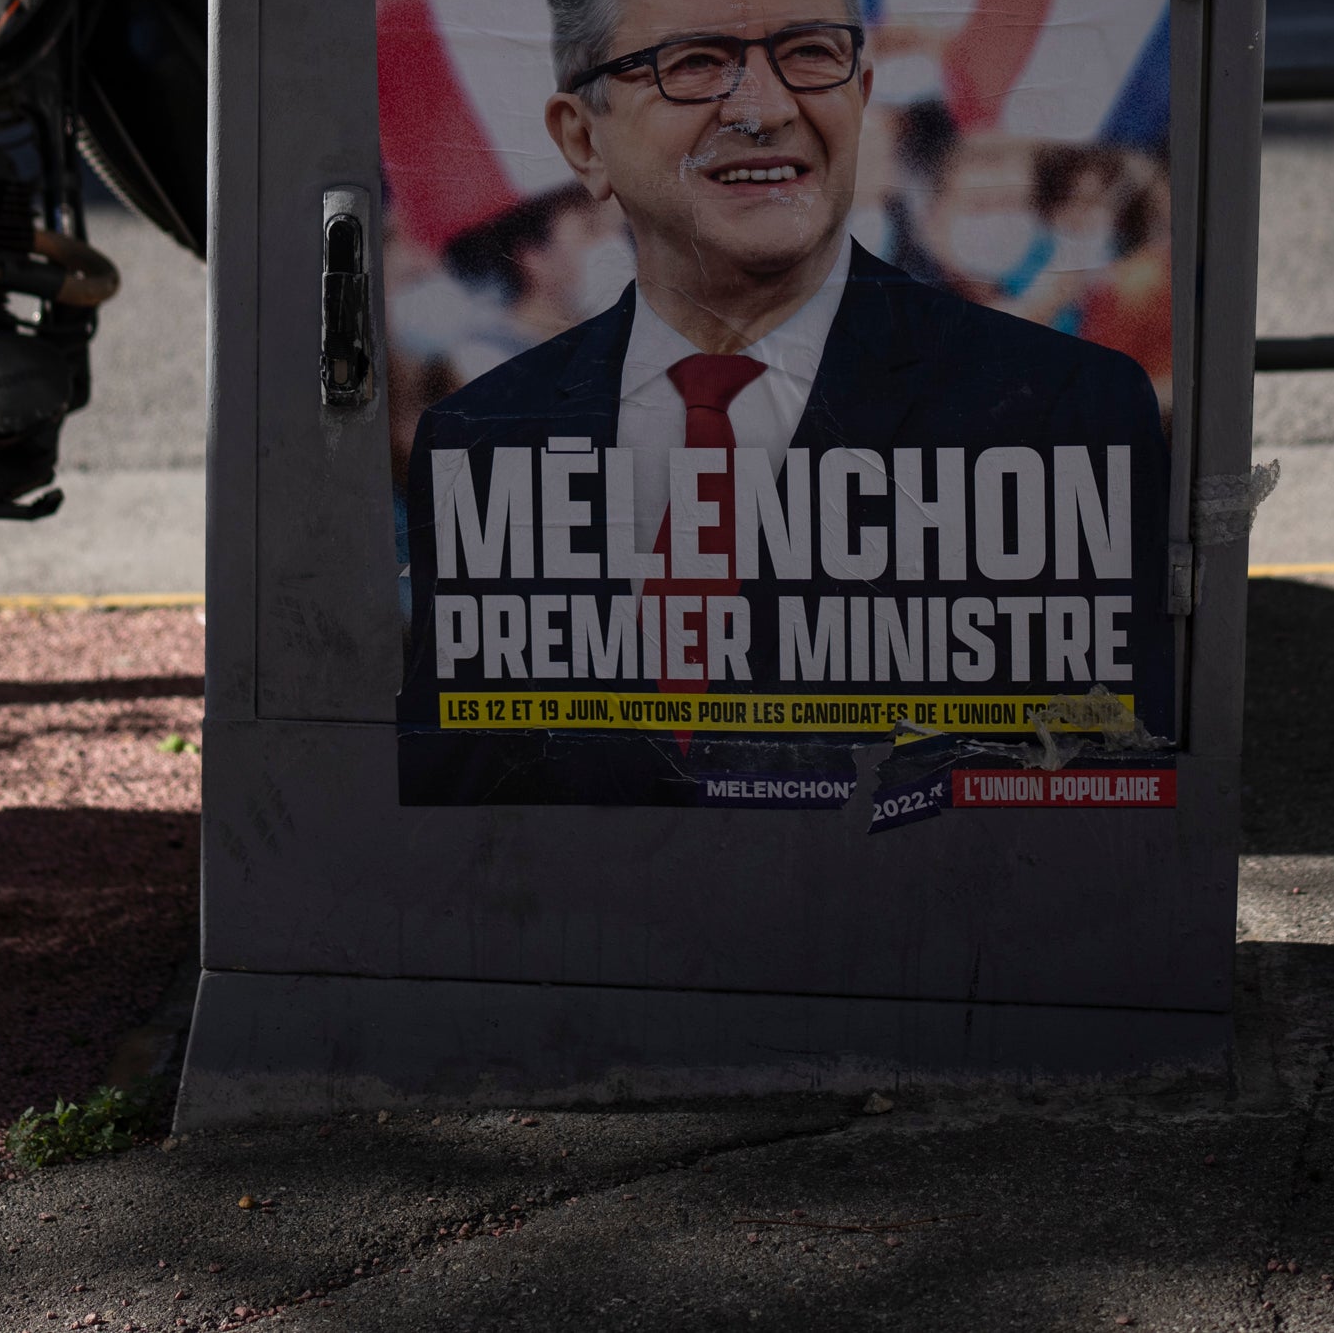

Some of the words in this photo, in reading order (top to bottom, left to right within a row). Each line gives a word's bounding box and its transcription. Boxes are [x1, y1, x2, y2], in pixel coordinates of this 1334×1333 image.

[434, 593, 754, 682] PREMIER
[777, 595, 1134, 683] MINISTRE
[447, 699, 479, 721] LES
[485, 699, 506, 721] 12
[511, 699, 533, 721] ET
[538, 699, 559, 721] 19
[566, 699, 615, 723] JUIN,
[619, 700, 692, 723] VOTONS
[698, 701, 747, 724] POUR
[753, 702, 785, 725] LES
[915, 702, 938, 725] DE
[1049, 776, 1161, 802] POPULAIRE
